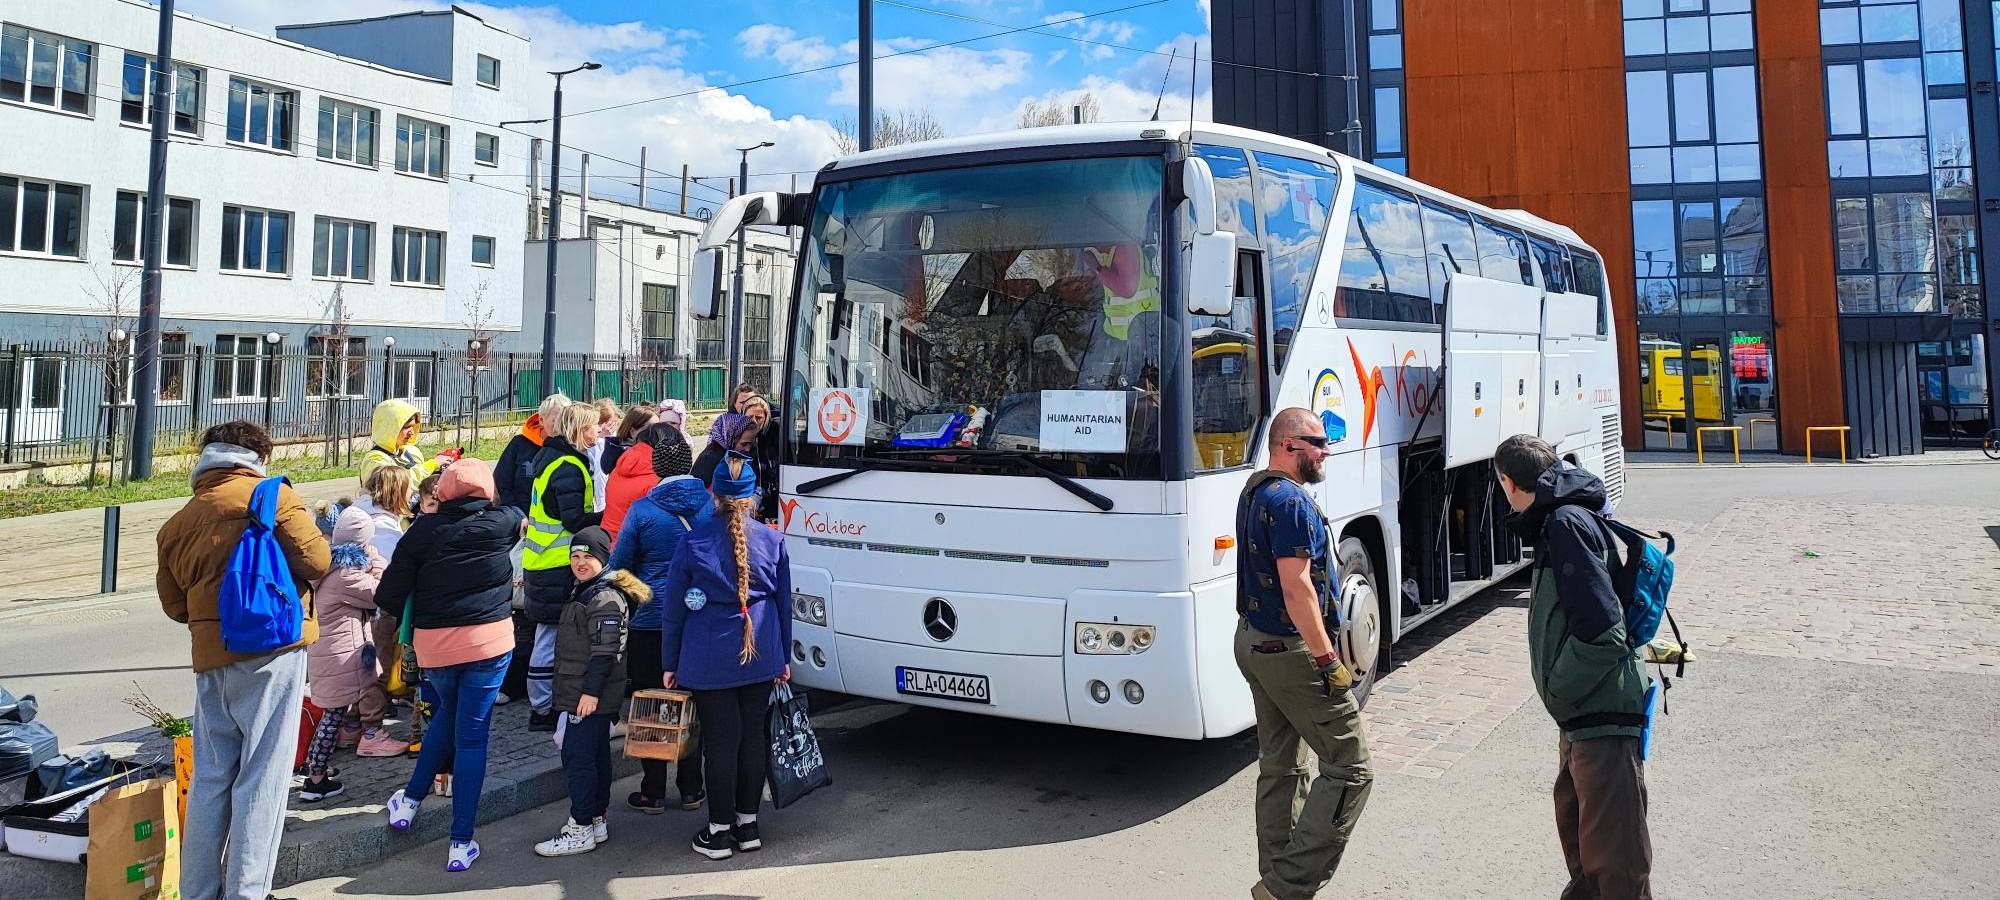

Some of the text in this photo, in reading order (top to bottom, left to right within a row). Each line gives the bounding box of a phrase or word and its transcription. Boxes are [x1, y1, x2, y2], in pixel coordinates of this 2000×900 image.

[1047, 413, 1122, 424] HUMANITARIAN
[1074, 426, 1092, 435] AID
[804, 510, 867, 535] Koliber
[905, 671, 985, 697] RLA 04466
